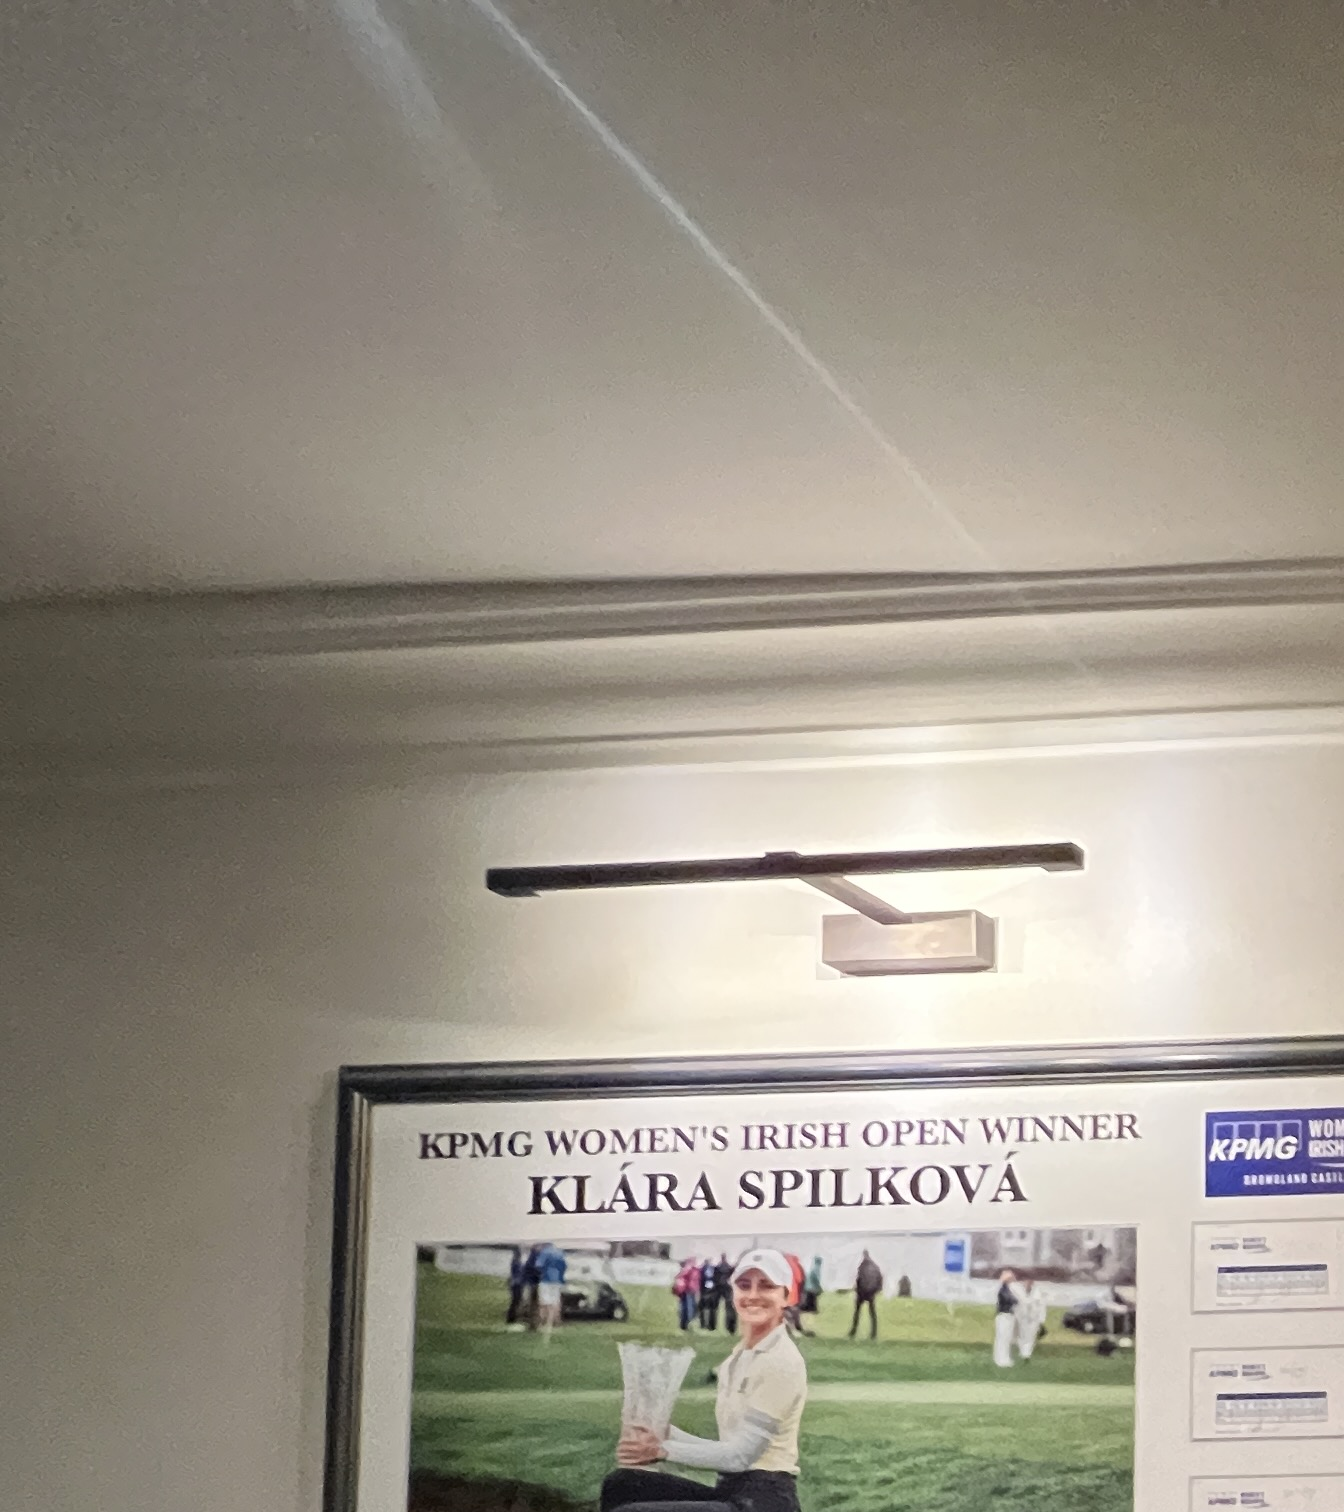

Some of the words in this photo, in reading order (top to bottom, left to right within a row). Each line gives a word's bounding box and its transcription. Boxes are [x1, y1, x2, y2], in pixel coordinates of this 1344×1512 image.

[417, 1131, 533, 1160] KPMG
[543, 1125, 731, 1157] WOMEN'S
[741, 1122, 849, 1151] IRISH
[861, 1118, 970, 1148] OPEN
[977, 1112, 1143, 1145] WINNER
[1208, 1135, 1299, 1162] KPMG
[526, 1160, 723, 1216] KLÁRA
[736, 1151, 1031, 1211] SPILKOVÁ
